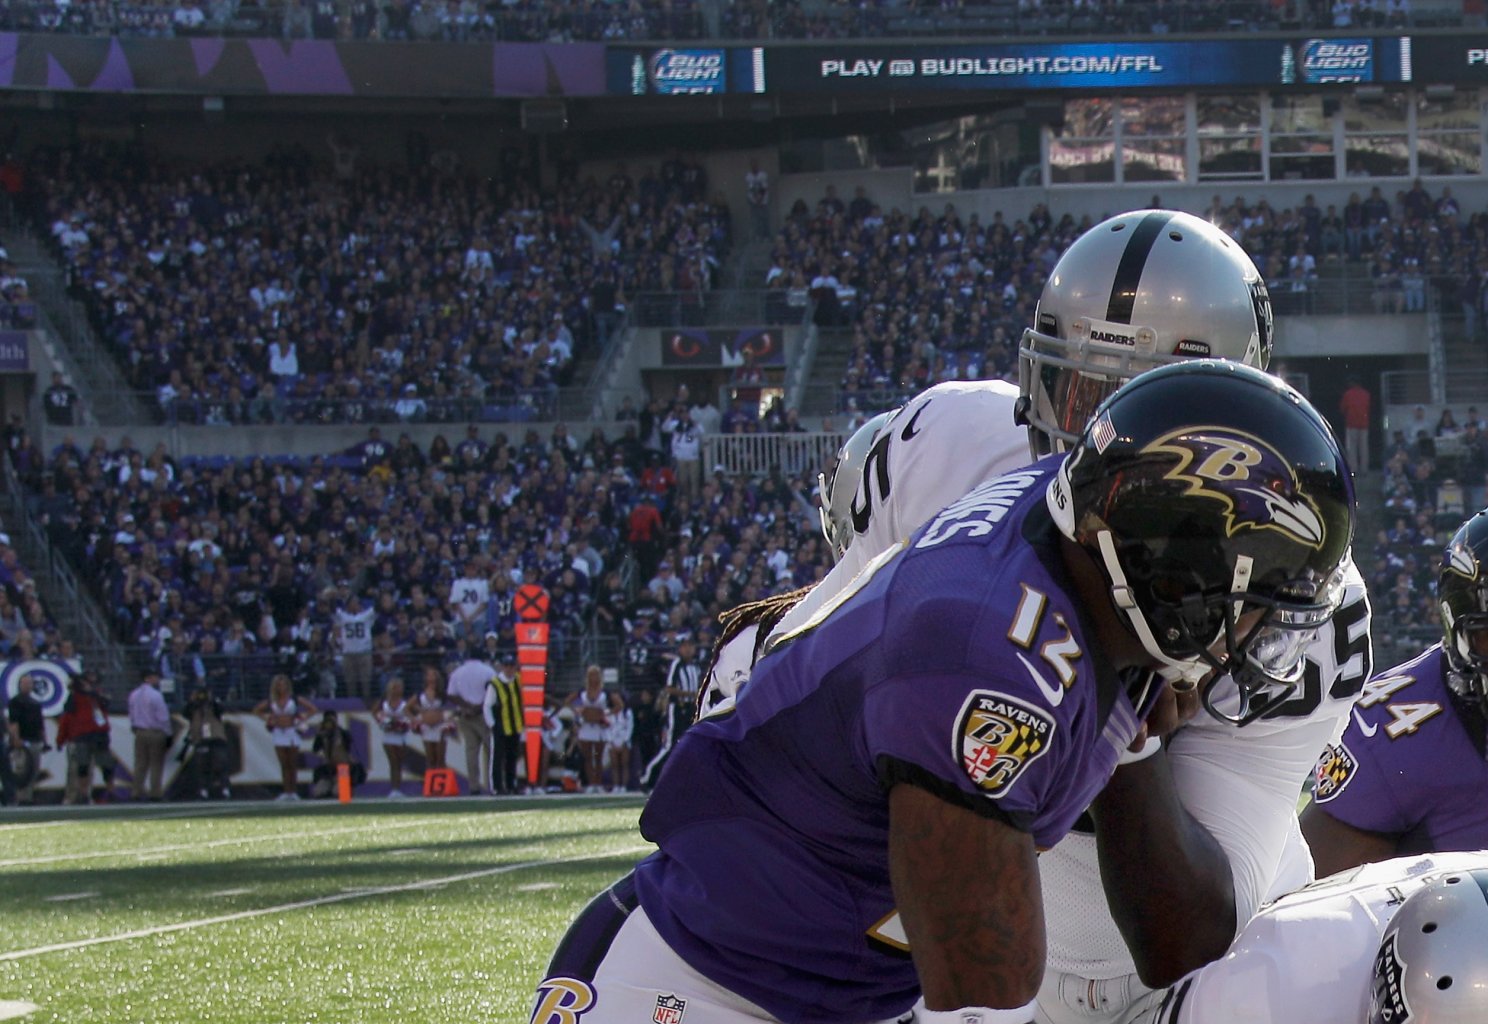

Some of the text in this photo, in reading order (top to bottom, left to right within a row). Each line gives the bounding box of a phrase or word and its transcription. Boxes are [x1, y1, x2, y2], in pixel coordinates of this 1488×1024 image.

[1316, 44, 1369, 57] BUD
[668, 55, 720, 67] BUD
[821, 56, 1163, 76] PLAY @ BUDLIGHT.COM/FFL
[1304, 56, 1371, 69] LIGHT
[655, 67, 721, 80] LIGHT
[1090, 329, 1136, 347] RAIDERS
[1178, 340, 1209, 354] RAIDERS
[1007, 581, 1083, 690] 12
[978, 697, 1049, 735] RAVENS
[1356, 674, 1443, 742] 44
[429, 773, 447, 794] G
[1384, 942, 1405, 1015] RAIDERS
[655, 1006, 680, 1024] NFL
